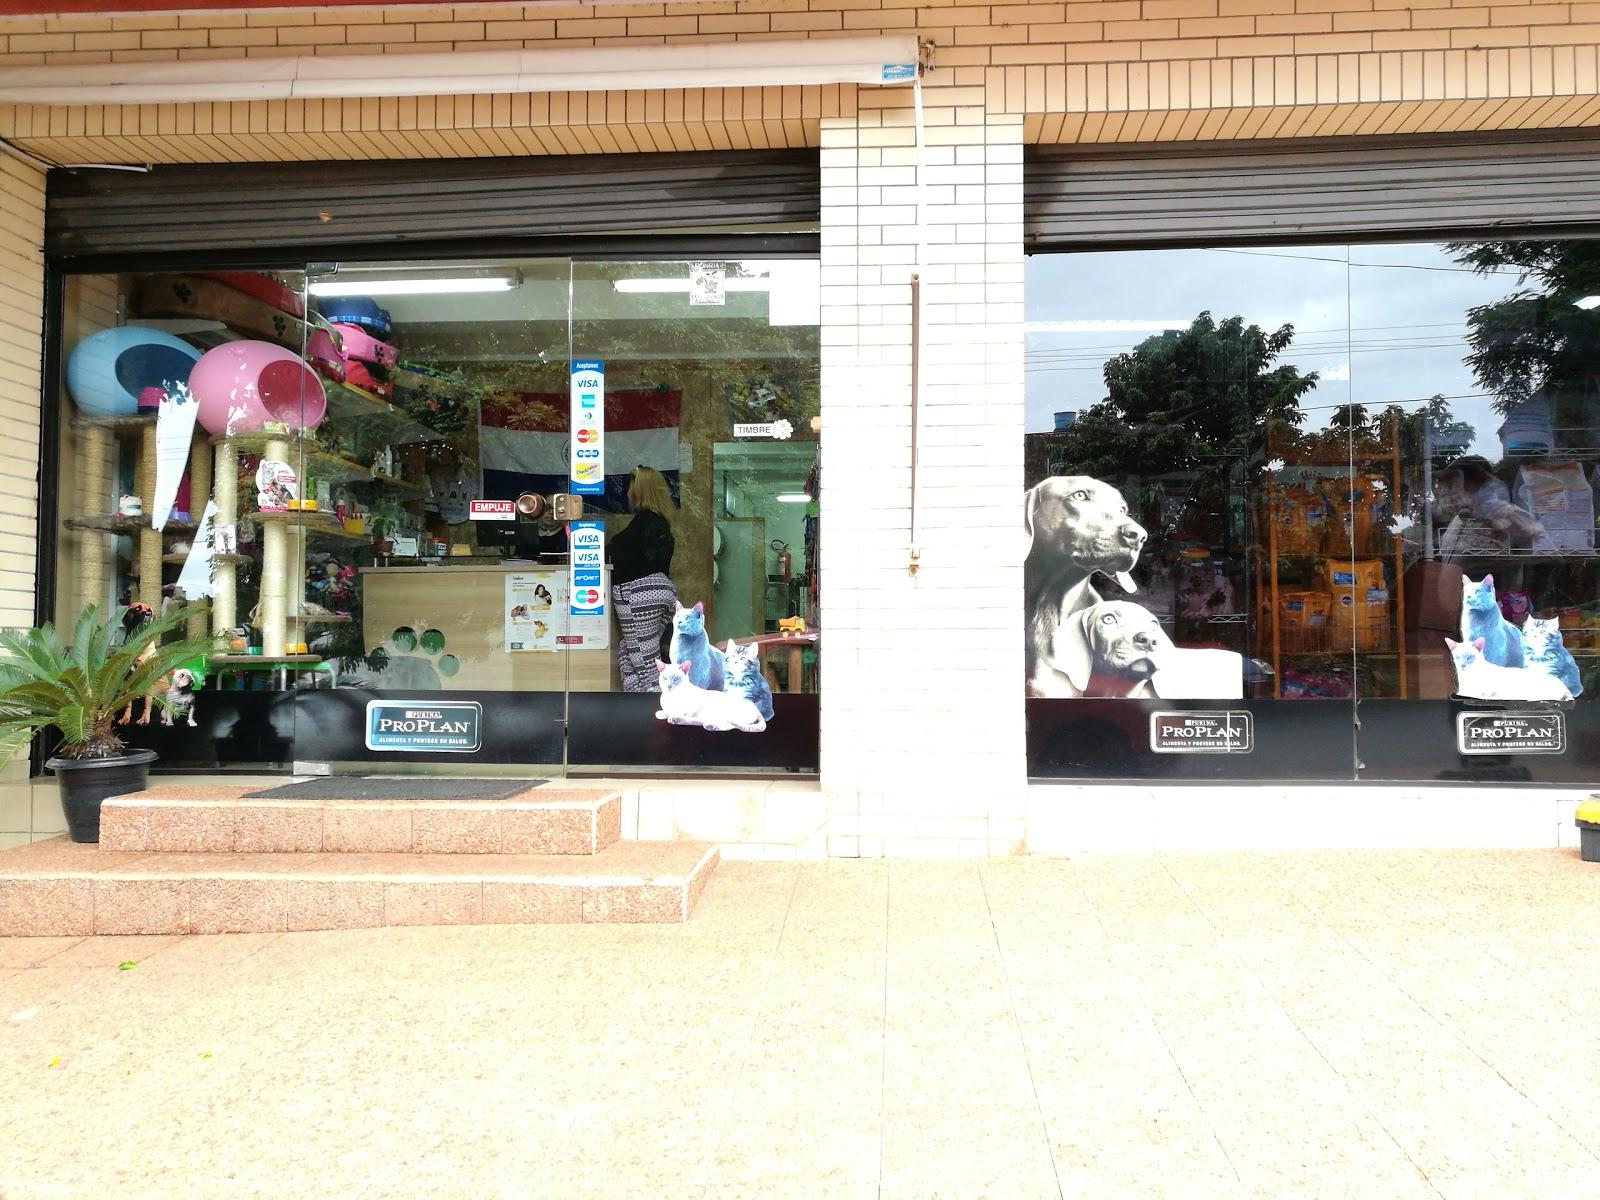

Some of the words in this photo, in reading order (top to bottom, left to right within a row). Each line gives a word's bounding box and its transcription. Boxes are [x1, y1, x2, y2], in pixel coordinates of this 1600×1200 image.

[737, 426, 770, 434] TIMBRE
[475, 503, 512, 512] EMPUJE
[578, 535, 599, 543] VISA
[578, 553, 599, 561] VISA
